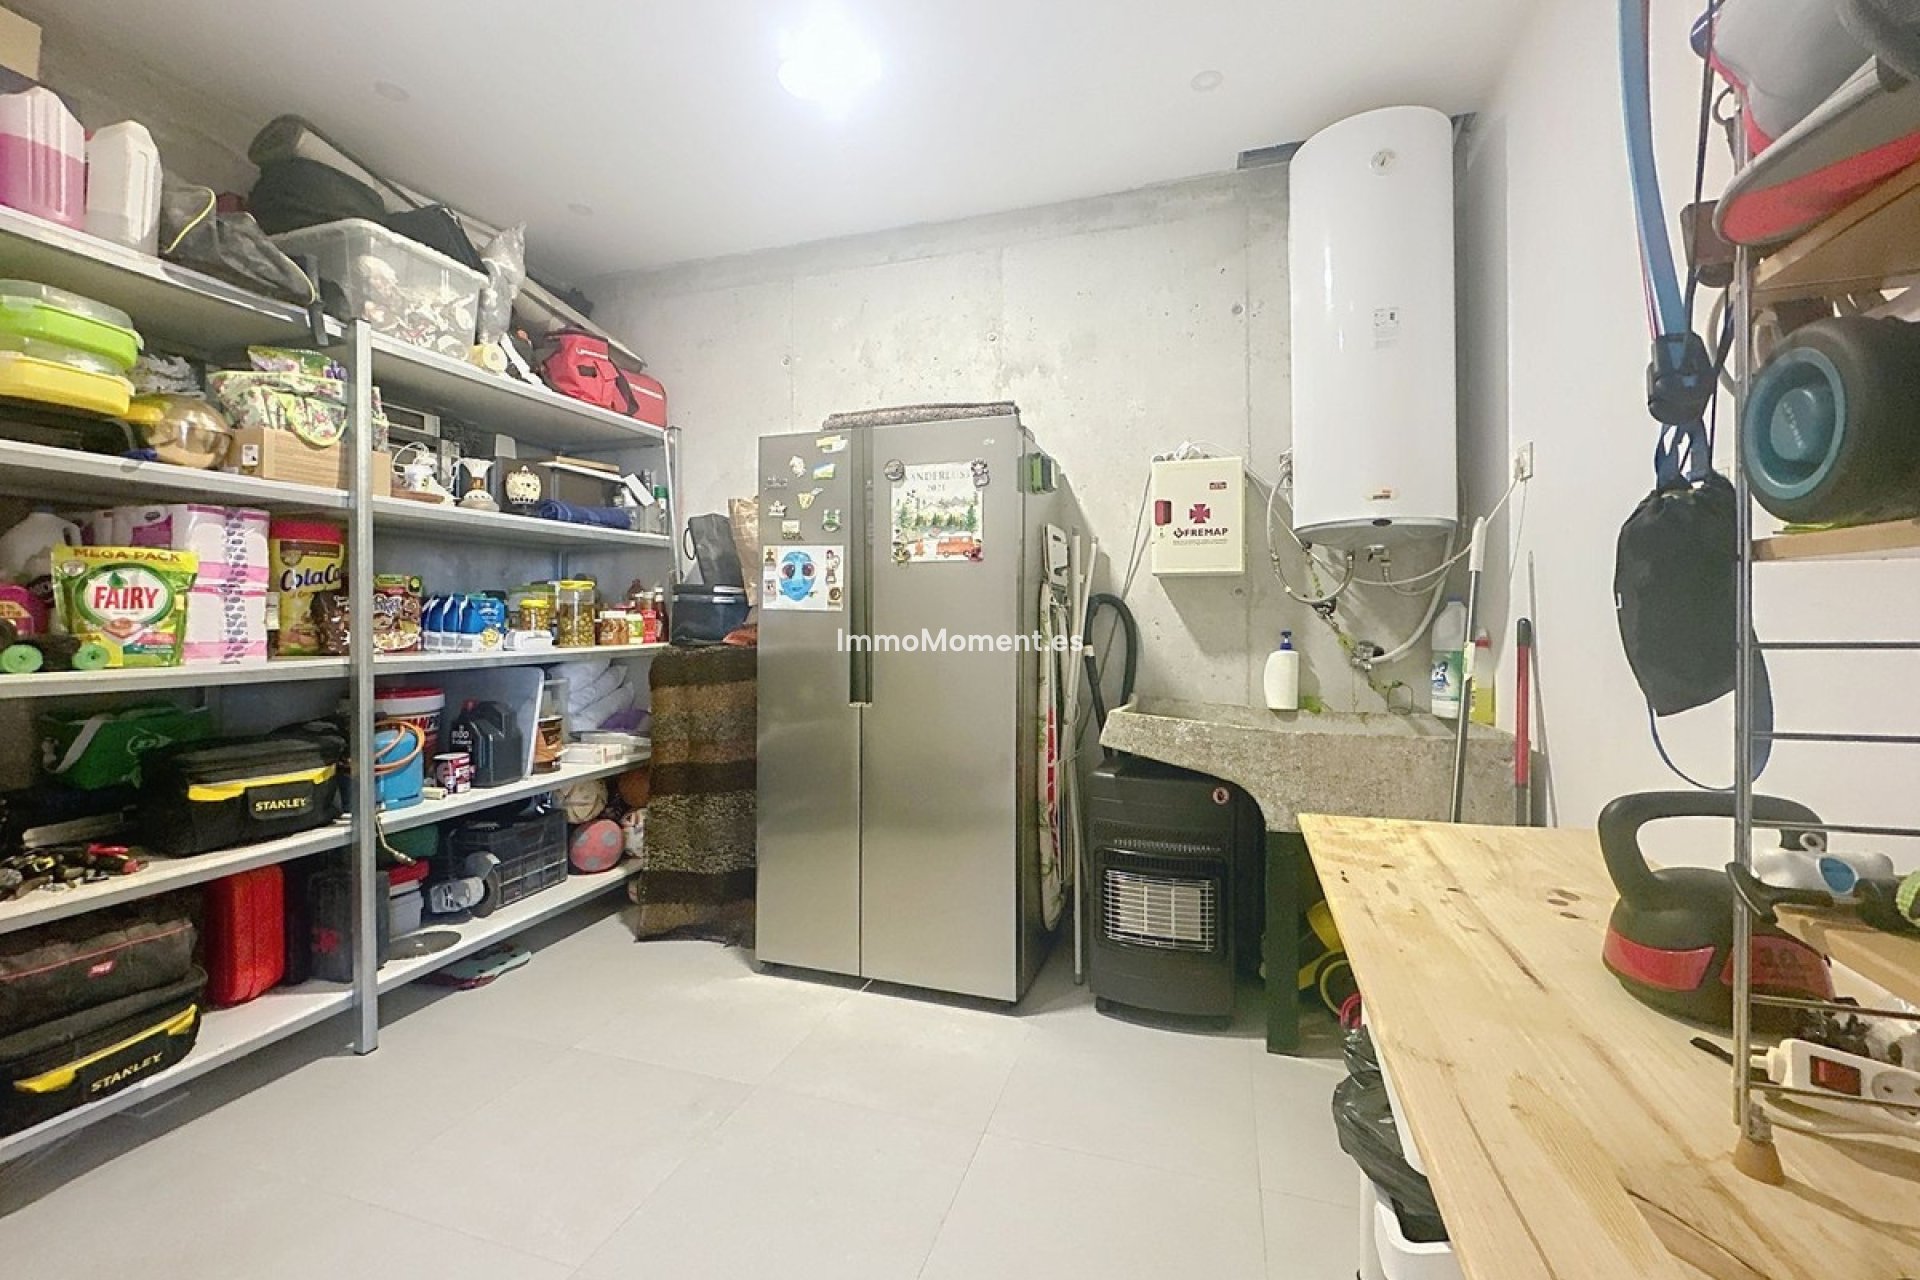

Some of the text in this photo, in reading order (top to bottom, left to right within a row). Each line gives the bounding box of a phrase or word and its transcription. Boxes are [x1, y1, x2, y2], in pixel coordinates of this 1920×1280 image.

[1183, 527, 1229, 538] FREMAP
[93, 586, 161, 610] FAIRY
[254, 796, 309, 813] STANLEY
[90, 1051, 164, 1093] STANLEY
